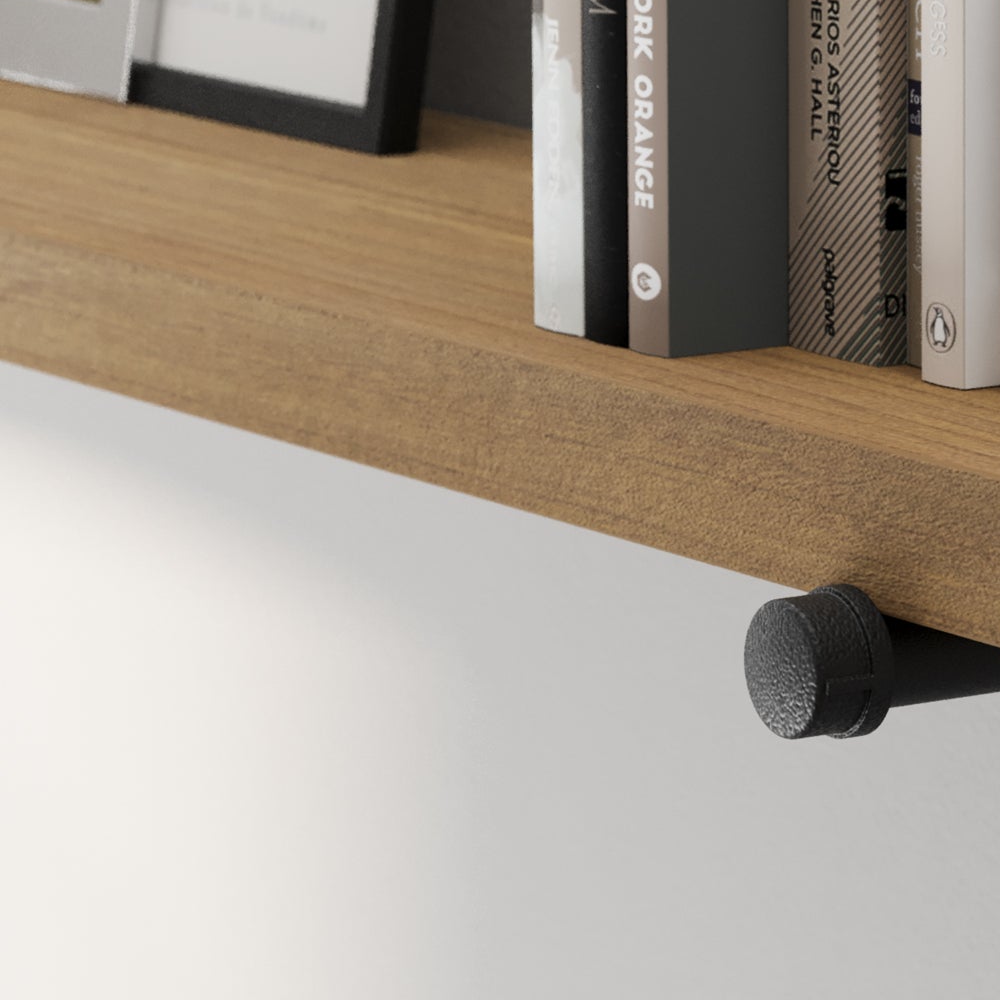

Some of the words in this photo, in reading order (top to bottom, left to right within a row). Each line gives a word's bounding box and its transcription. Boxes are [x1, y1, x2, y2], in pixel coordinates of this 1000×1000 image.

[811, 47, 823, 73] G.
[633, 74, 655, 209] ORANGE
[811, 78, 823, 142] HALL
[826, 63, 841, 187] ASTERIOU
[822, 247, 838, 337] palgrave
